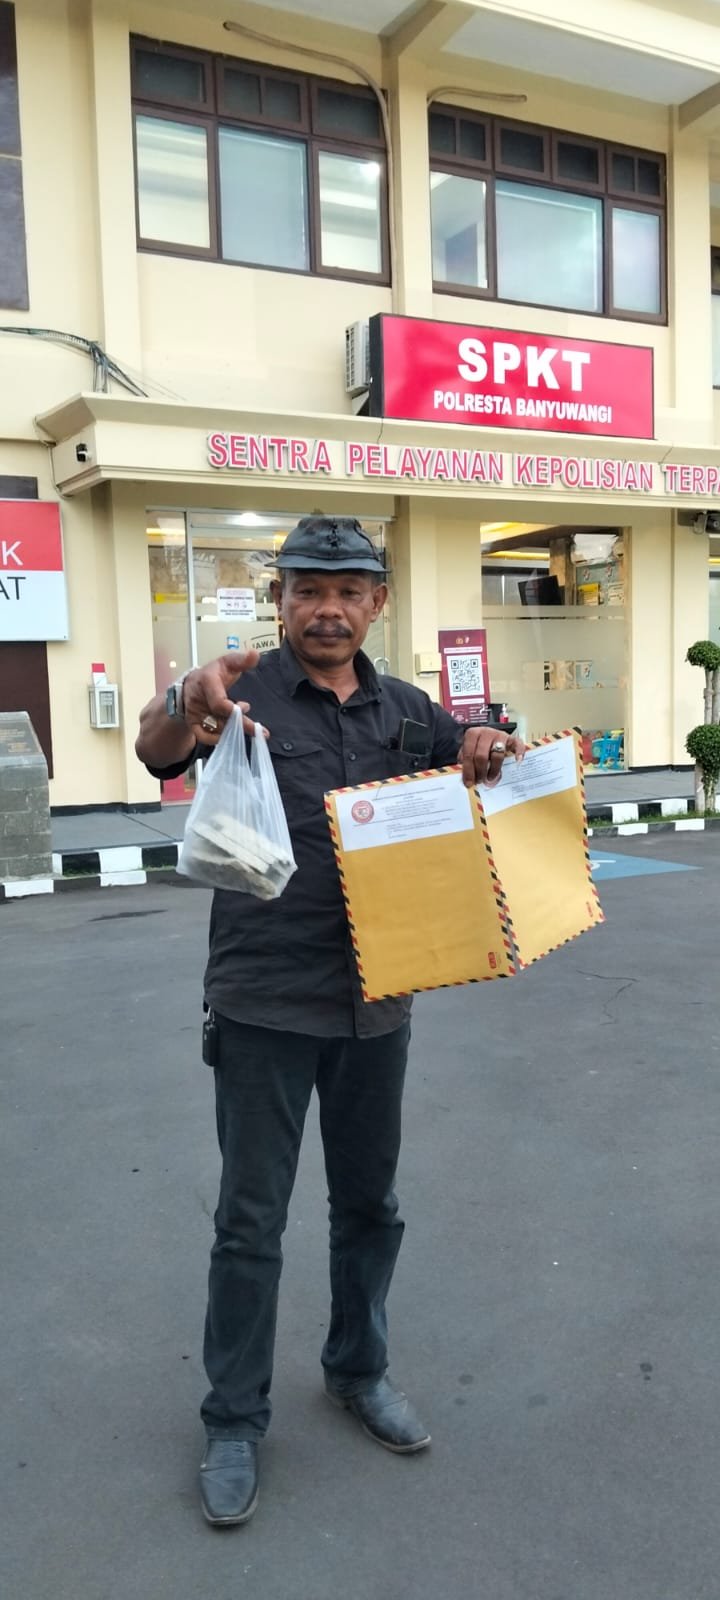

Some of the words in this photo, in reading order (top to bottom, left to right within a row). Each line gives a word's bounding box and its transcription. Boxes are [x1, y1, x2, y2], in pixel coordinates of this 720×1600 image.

[457, 338, 590, 390] SPKT
[433, 390, 511, 415] POLRESTA
[516, 397, 611, 423] BANYUWANGI
[208, 431, 332, 472] SENTRA
[346, 442, 504, 481] PELAYANAN
[516, 454, 653, 490] KEPOLISIAN
[664, 463, 720, 496] TERP
